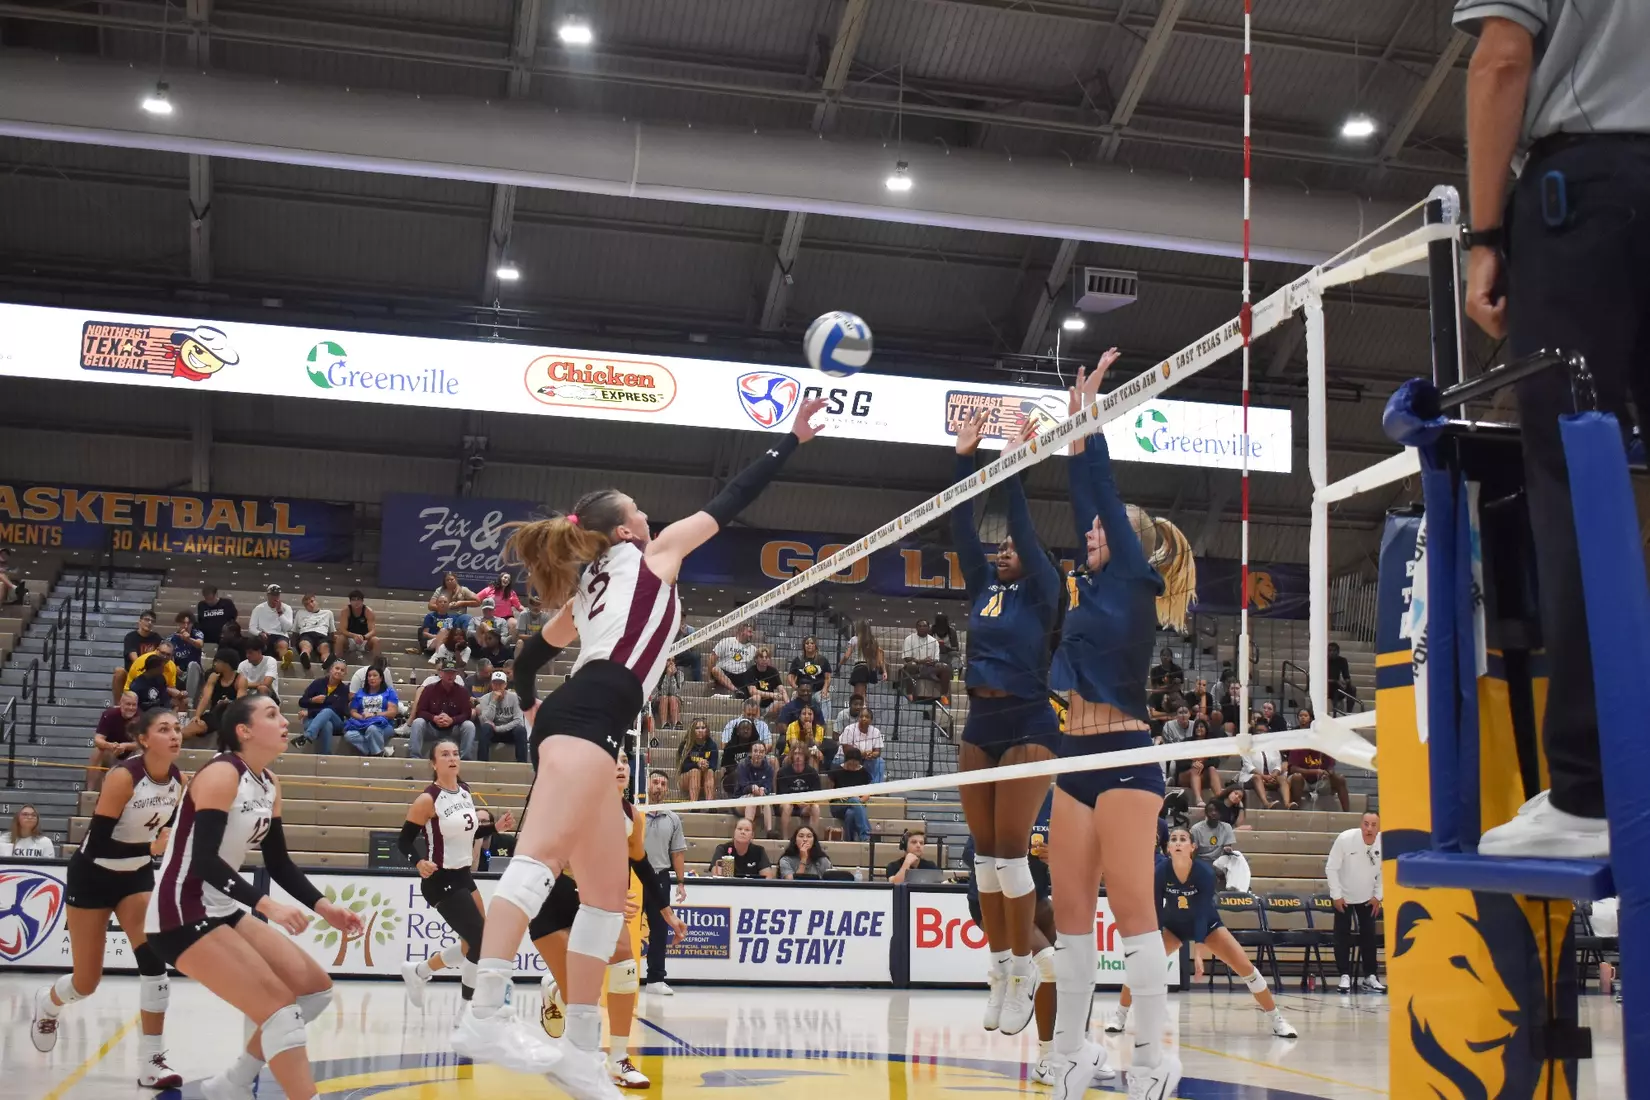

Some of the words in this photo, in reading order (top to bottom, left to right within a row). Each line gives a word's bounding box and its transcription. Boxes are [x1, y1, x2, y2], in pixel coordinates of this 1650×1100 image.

[85, 336, 147, 357] TEXAS
[86, 325, 149, 340] NORTHEAST
[83, 354, 146, 370] GELLYBALL
[1175, 350, 1194, 370] EAST
[1195, 332, 1221, 357] TEXAS
[328, 361, 459, 395] Greenville
[547, 361, 656, 389] Chicken
[601, 390, 657, 403] EXPRESS
[949, 393, 1001, 407] NORTHEAST
[1102, 395, 1118, 412] EAST
[1119, 380, 1142, 401] TEXAS
[1039, 429, 1055, 447] EAST
[1055, 418, 1073, 438] TEXAS
[1152, 427, 1262, 458] Greenville
[418, 506, 471, 543] Fix
[469, 510, 503, 551] &
[138, 531, 291, 561] ALL-AMERICANS
[430, 538, 504, 575] Feed
[760, 540, 870, 585] GO
[586, 571, 611, 621] 2
[143, 812, 161, 832] 4
[462, 813, 475, 832] 3
[1220, 897, 1253, 906] LIONS
[1268, 898, 1301, 907] LIONS
[1314, 898, 1332, 907] LIO
[736, 908, 803, 935] BEST
[806, 910, 886, 937] PLACE
[738, 937, 772, 964] TO
[775, 938, 847, 965] STAY!
